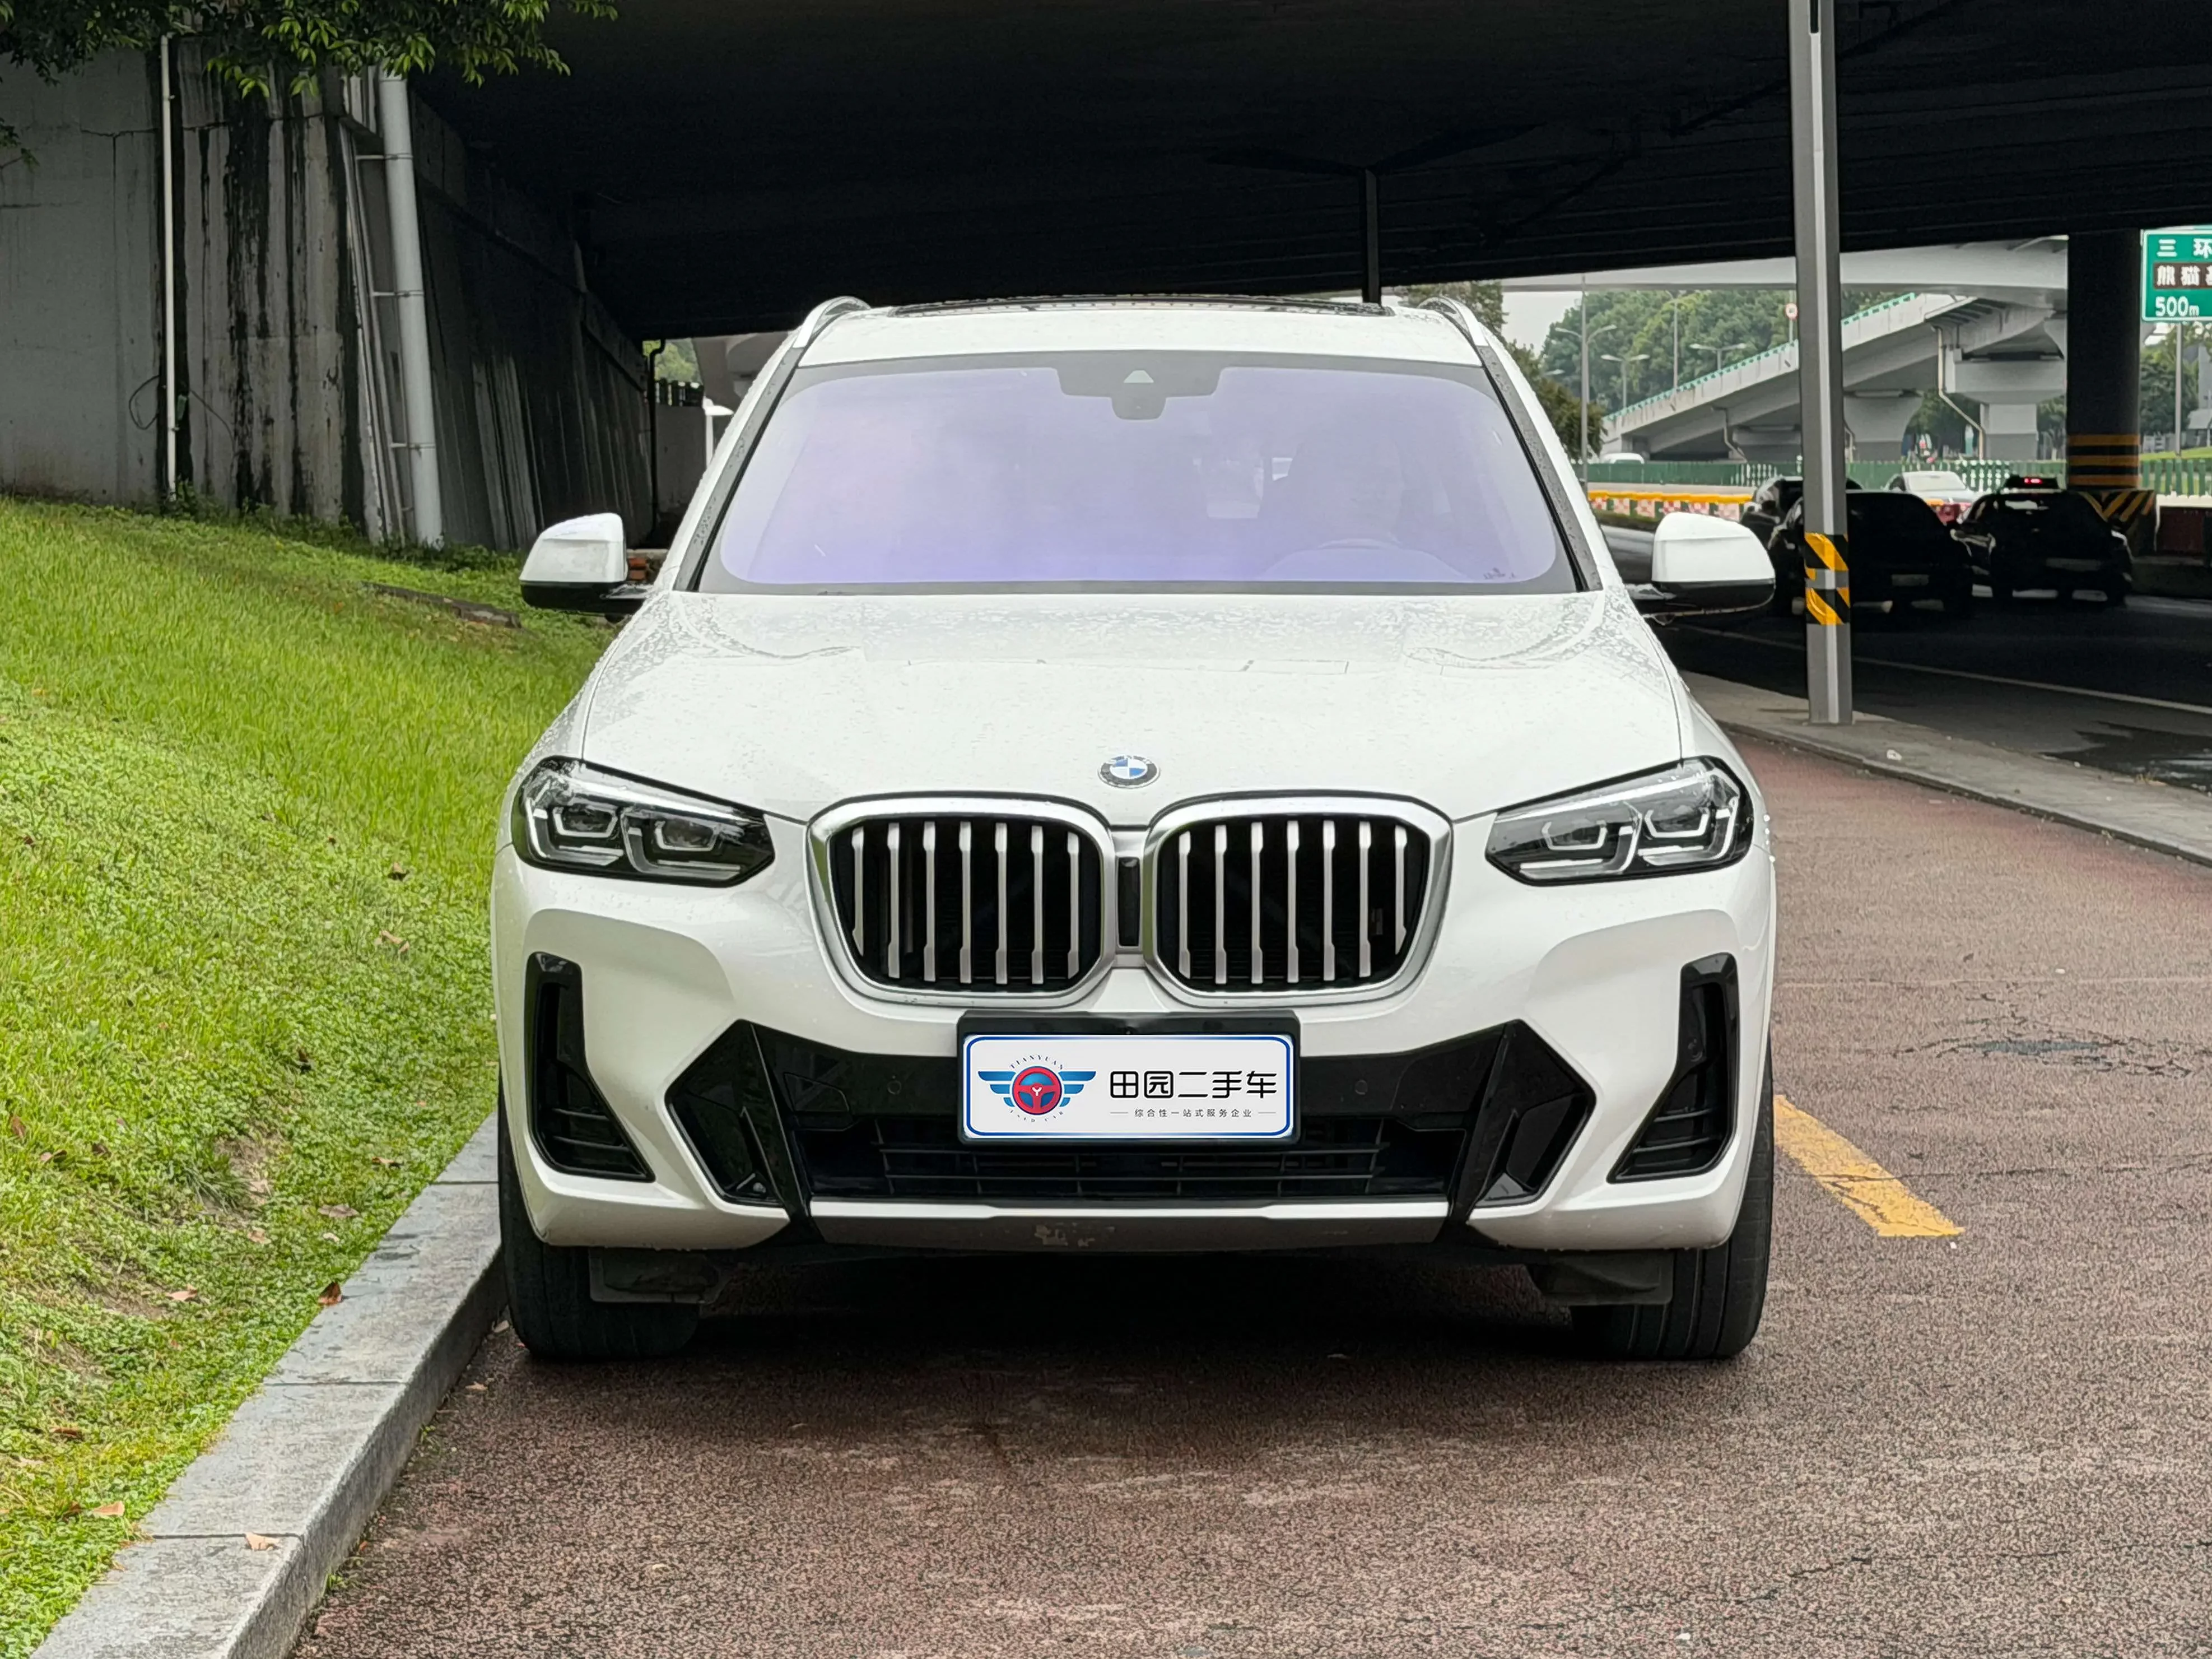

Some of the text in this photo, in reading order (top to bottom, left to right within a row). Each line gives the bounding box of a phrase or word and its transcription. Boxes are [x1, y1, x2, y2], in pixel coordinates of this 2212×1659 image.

[2155, 296, 2200, 317] 500m
[1110, 1071, 1277, 1098] 田园二手车
[1134, 1108, 1252, 1118] 综合性一站式服务企业
